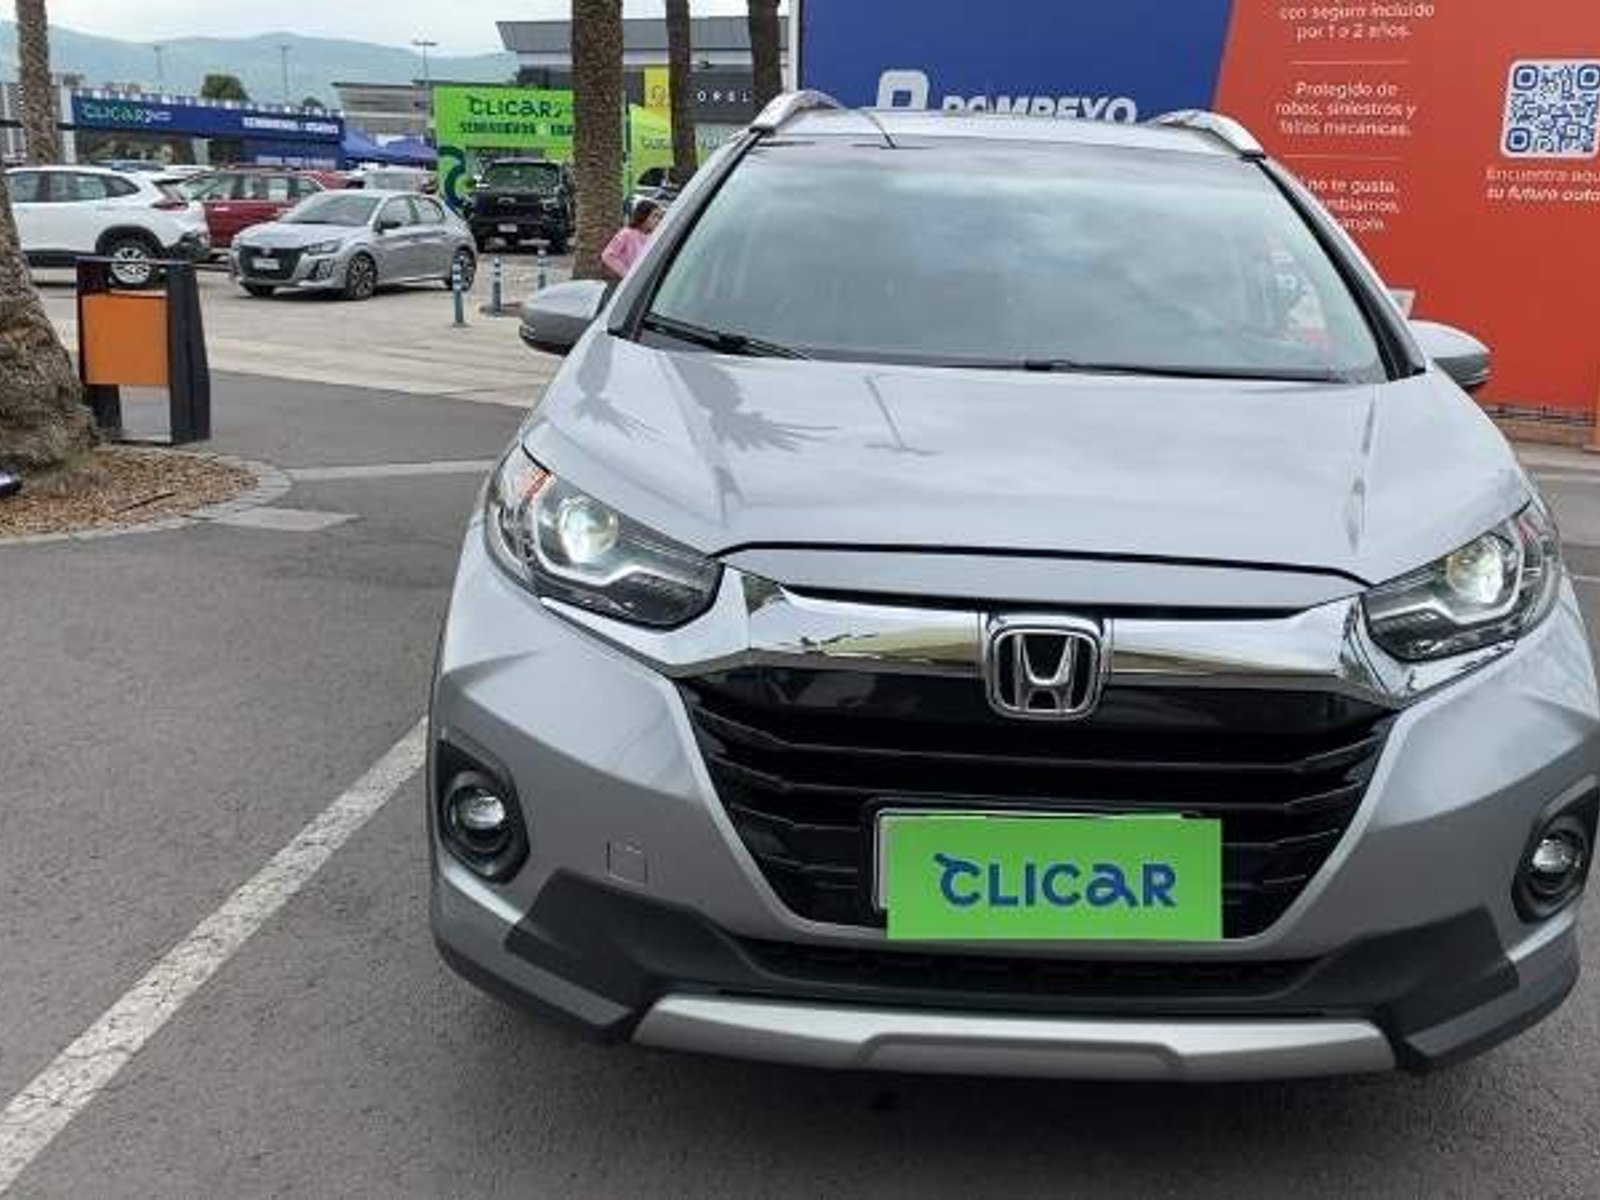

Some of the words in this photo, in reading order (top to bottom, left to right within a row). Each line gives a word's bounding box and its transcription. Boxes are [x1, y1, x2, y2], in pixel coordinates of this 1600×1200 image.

[1371, 2, 1435, 18] incluido
[1297, 26, 1323, 43] por
[1353, 24, 1363, 38] 2
[1296, 81, 1372, 99] Protegido
[1377, 82, 1398, 96] de
[1327, 101, 1402, 116] siniestros
[1405, 104, 1416, 120] y
[1308, 179, 1327, 192] no
[1332, 178, 1346, 192] te
[1572, 169, 1600, 185] aqu
[1487, 186, 1505, 199] tu
[1508, 185, 1558, 201] futuro
